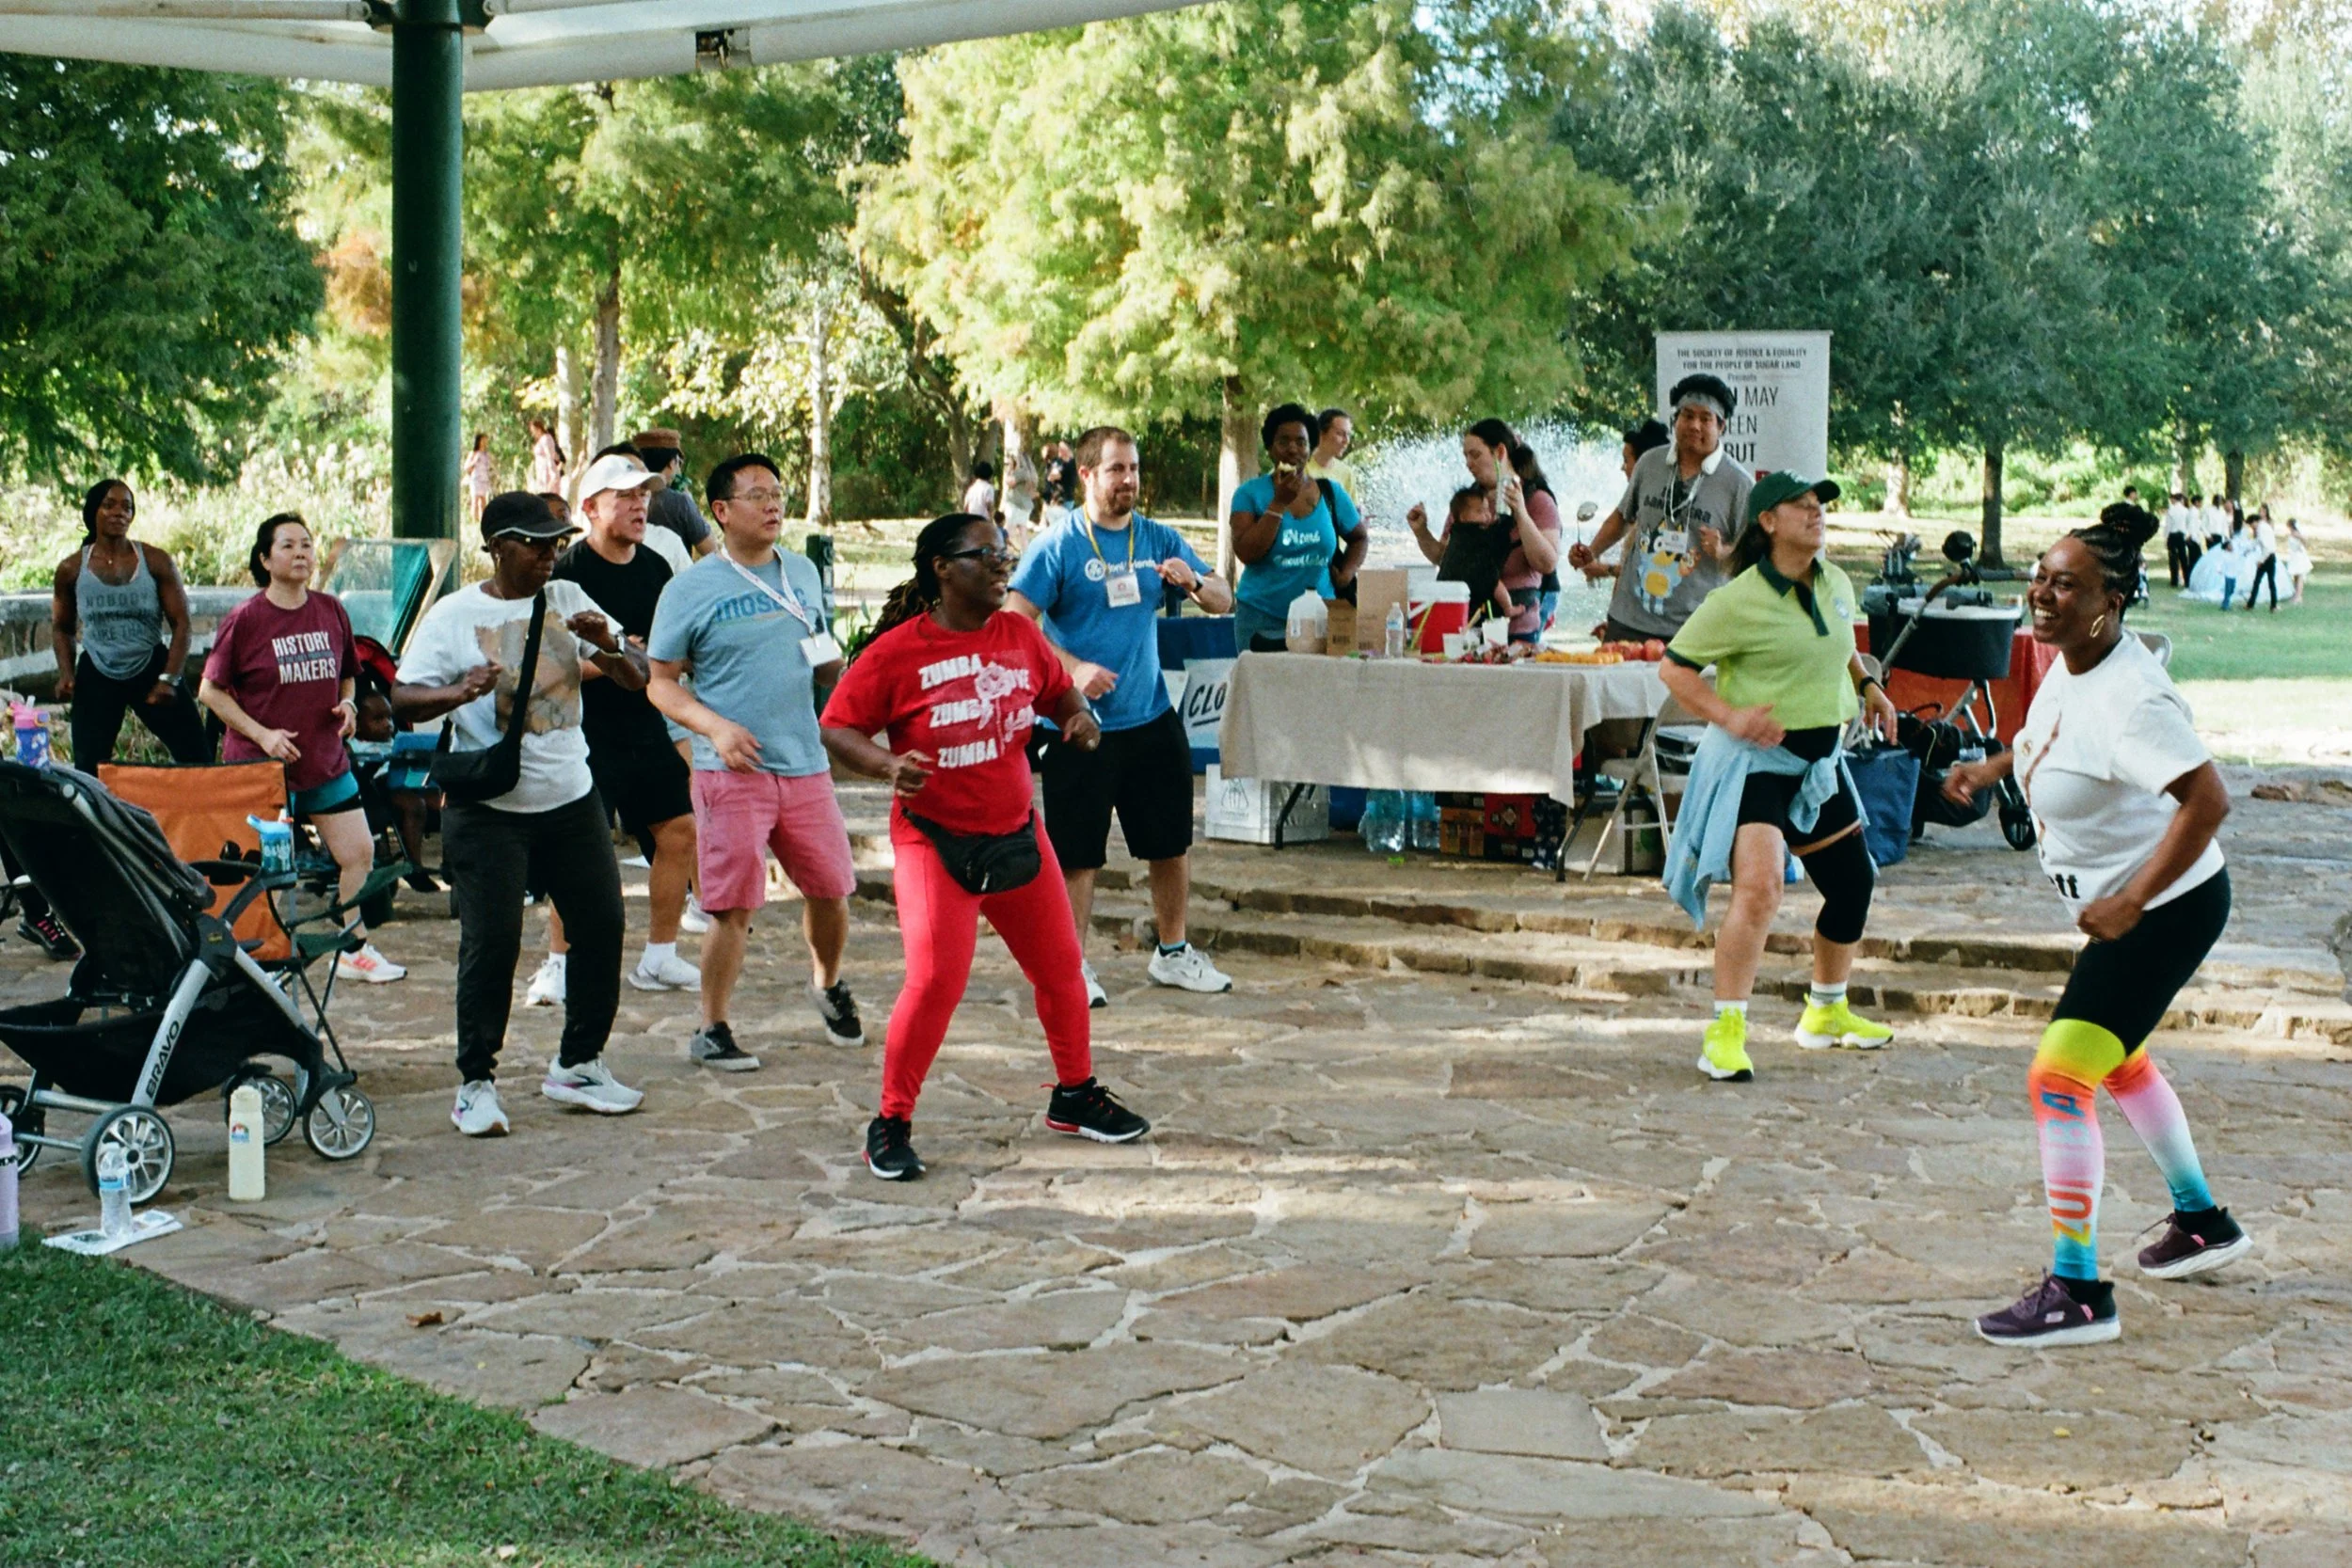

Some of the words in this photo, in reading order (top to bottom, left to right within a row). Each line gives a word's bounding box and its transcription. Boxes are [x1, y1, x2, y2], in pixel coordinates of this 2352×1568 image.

[1677, 348, 1690, 357] THE
[1692, 348, 1723, 357] SOCIETY
[1724, 348, 1733, 357] OF
[1736, 348, 1763, 357] JUSTICE
[1772, 347, 1807, 357] EQUALITY
[1682, 360, 1697, 370] FOR
[1699, 360, 1712, 370] THE
[1715, 360, 1741, 370] PEOPLE
[1743, 360, 1753, 370] OF
[1755, 360, 1780, 370] SUGAR
[1781, 360, 1801, 370] LAND
[1745, 387, 1779, 406] MAY
[1724, 415, 1757, 435] EEN
[85, 592, 149, 609] NOBODY
[271, 631, 330, 657] HISTORY
[278, 657, 337, 685] MAKERS
[918, 653, 982, 691] ZUMBA
[937, 737, 998, 768] ZUMBA
[146, 1020, 180, 1099] BRAVO
